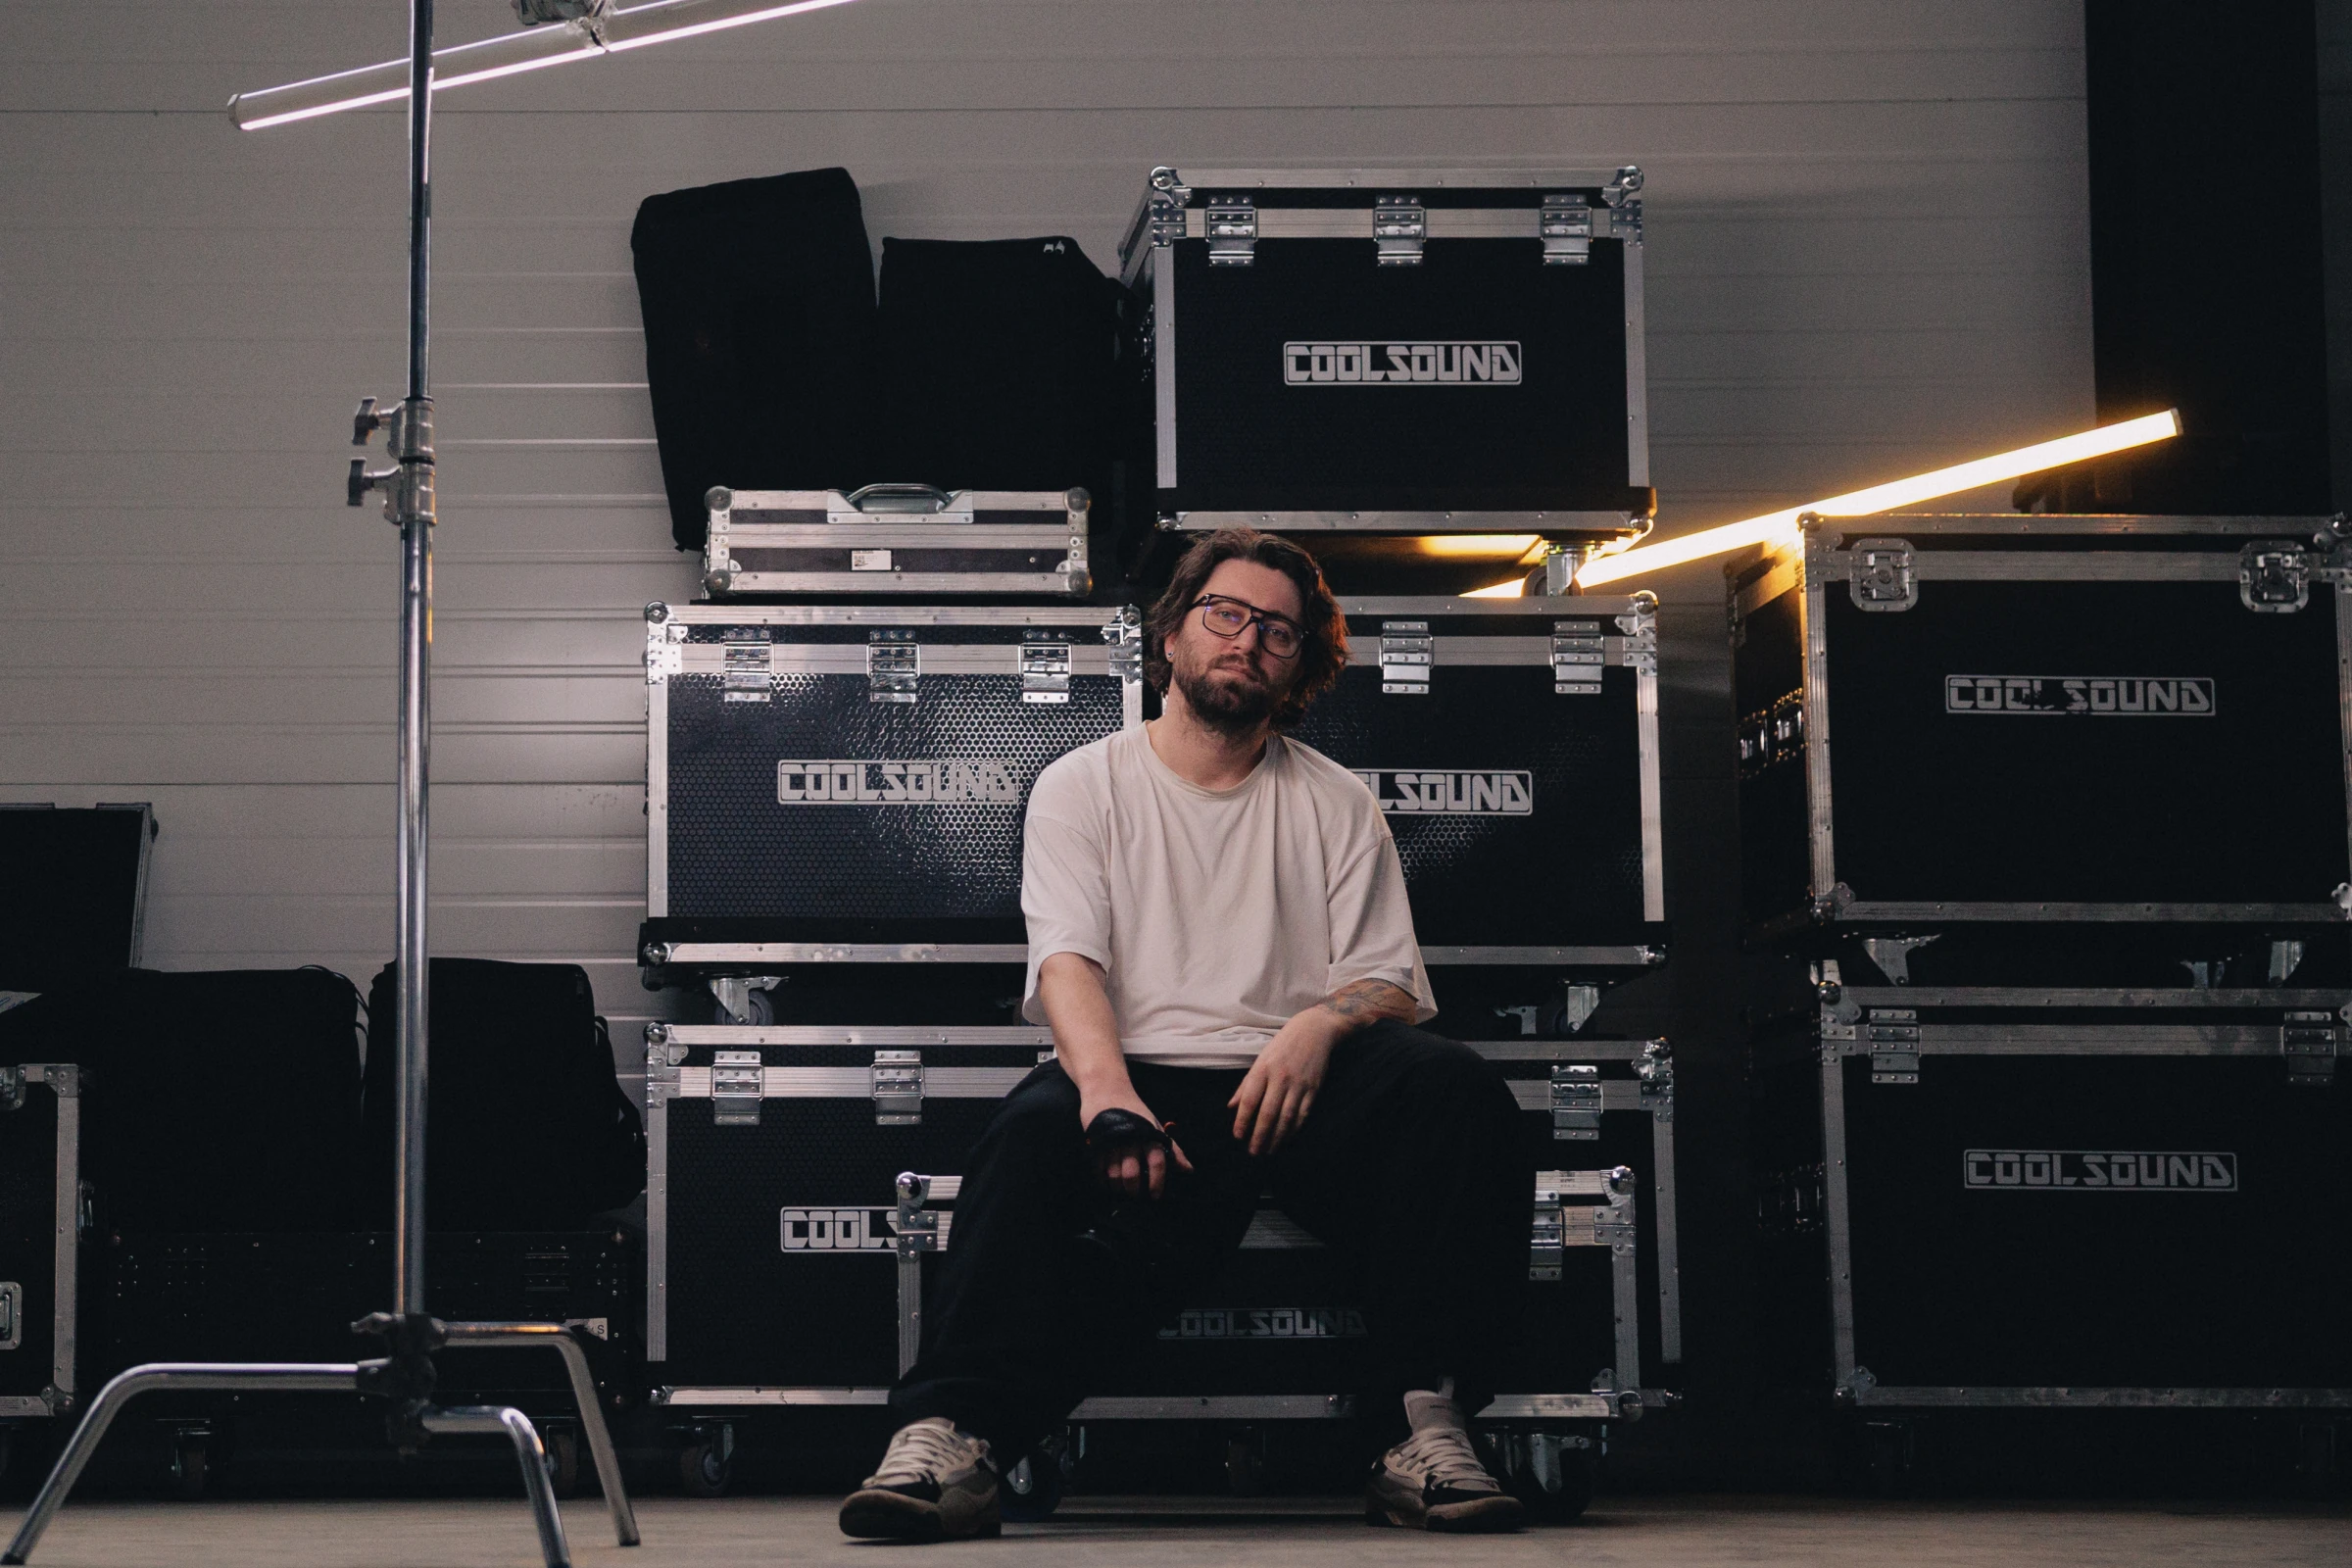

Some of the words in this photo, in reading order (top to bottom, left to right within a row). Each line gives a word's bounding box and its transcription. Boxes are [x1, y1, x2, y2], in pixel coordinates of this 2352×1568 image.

[1286, 345, 1520, 382] COOLSOUND
[780, 763, 1017, 802] COOLSOUND
[1355, 772, 1531, 811] LSOUND
[1967, 1152, 2232, 1188] COOLSOUND
